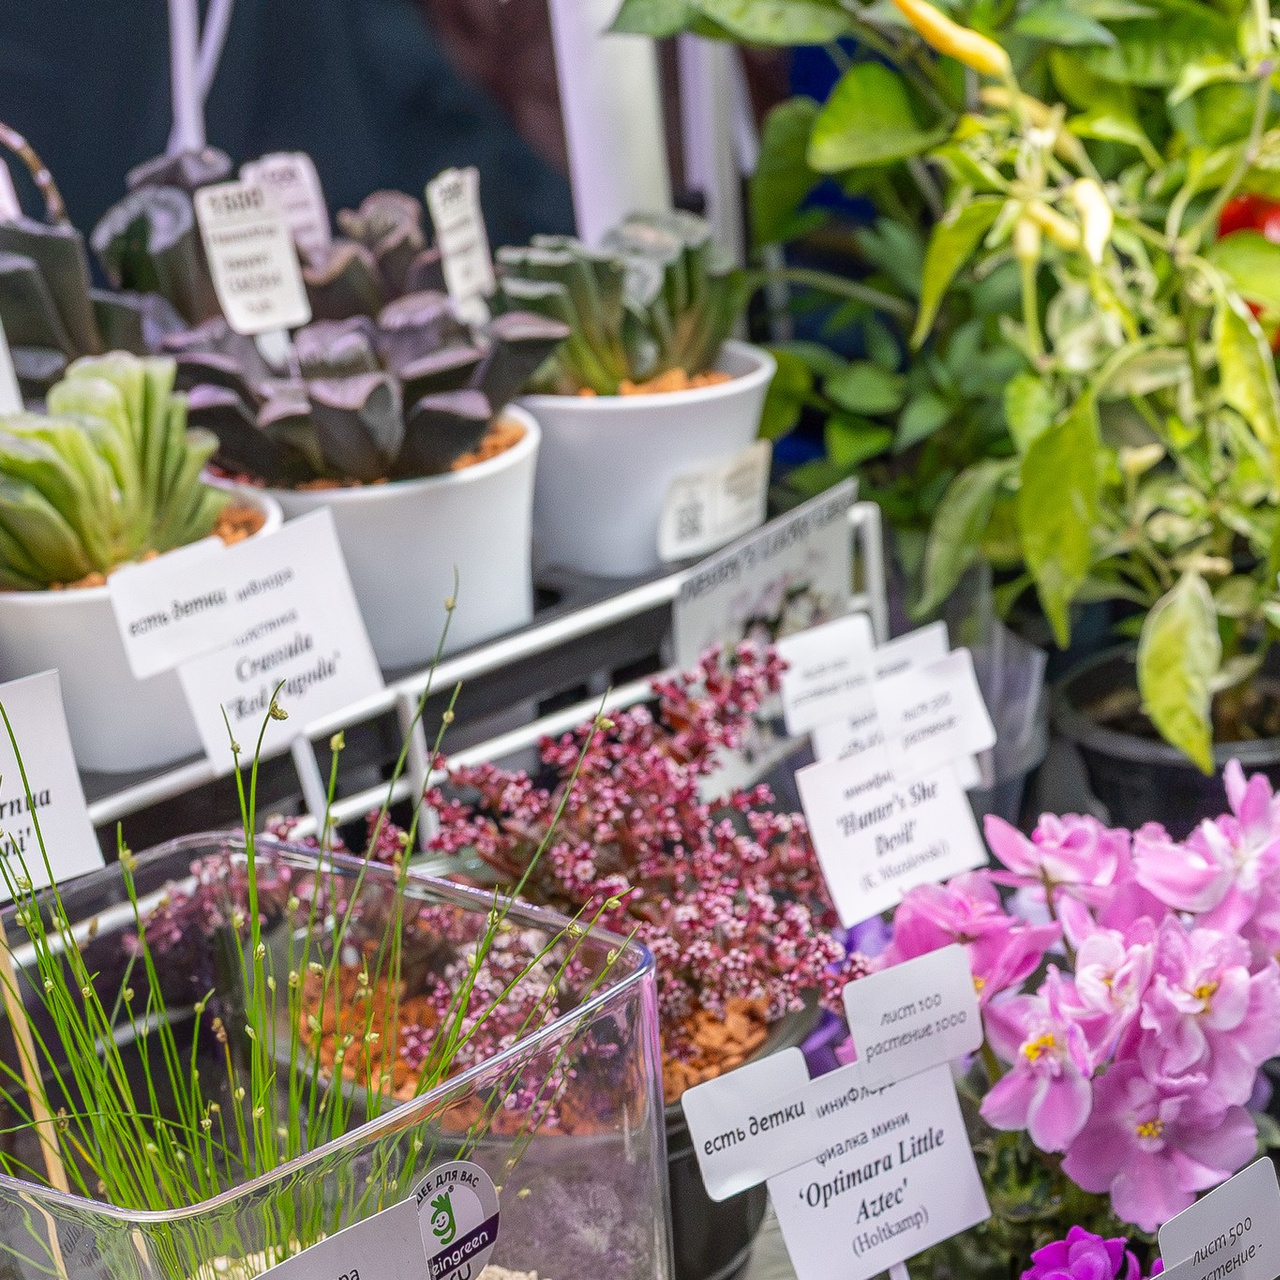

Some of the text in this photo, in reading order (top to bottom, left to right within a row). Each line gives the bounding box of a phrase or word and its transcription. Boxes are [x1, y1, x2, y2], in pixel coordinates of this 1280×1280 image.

[0, 787, 51, 821] rnua
[879, 992, 942, 1028] лист 100
[865, 1010, 968, 1063] растение 1000
[703, 1099, 807, 1156] есть детки
[815, 1111, 911, 1168] фиалка мини
[897, 1126, 946, 1165] Little
[435, 1169, 458, 1189] ДЛЯ
[460, 1170, 480, 1188] ВАС
[855, 1177, 910, 1226] Aztec'
[431, 1231, 489, 1277] eingreen
[852, 1203, 930, 1258] (Holtkamp)
[1192, 1216, 1253, 1267] лист 500
